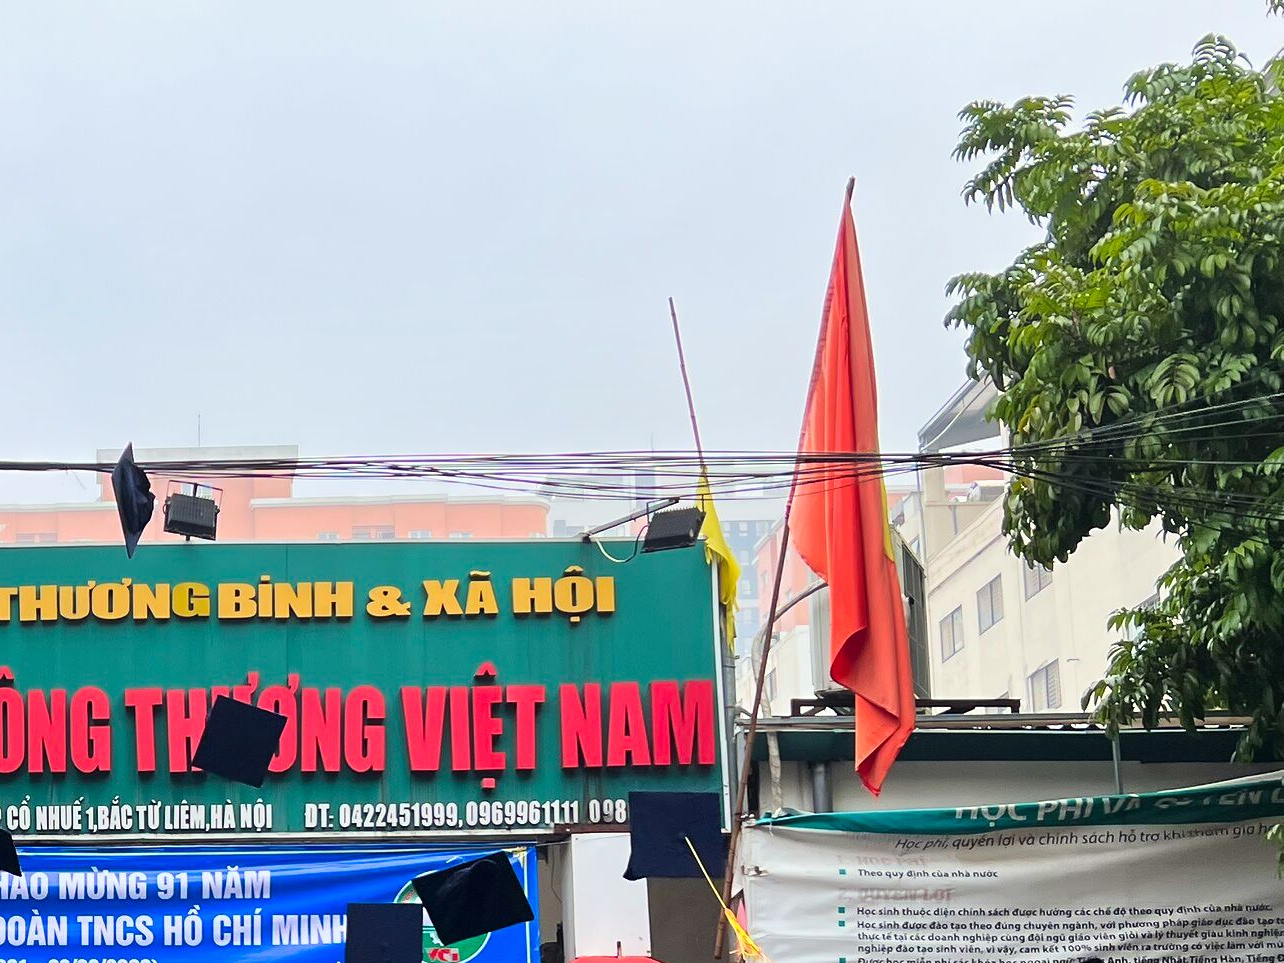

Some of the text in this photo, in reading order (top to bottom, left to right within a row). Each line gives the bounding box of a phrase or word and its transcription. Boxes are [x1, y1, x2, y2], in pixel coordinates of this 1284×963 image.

[366, 585, 411, 617] &
[422, 569, 499, 616] XÃ
[512, 564, 615, 622] HỘI
[400, 660, 546, 790] VIỆT
[559, 679, 716, 769] NAM
[7, 795, 31, 830] CỔ
[35, 797, 85, 831] NHUẾ
[137, 799, 162, 831] TỪ
[240, 798, 272, 833] NỘI
[304, 803, 334, 829] ĐT:
[339, 802, 463, 829] 0422451999,
[465, 800, 579, 826] 0969961111
[1018, 833, 1035, 846] và
[1082, 830, 1114, 845] sách
[59, 865, 147, 900] MỪNG
[157, 871, 190, 899] 91
[201, 865, 271, 899] NĂM
[858, 868, 883, 877] Theo
[885, 870, 904, 879] quy
[79, 914, 154, 947] TNCS
[163, 904, 202, 947] HỒ
[213, 908, 261, 947] CHÍ
[272, 913, 348, 946] MINH
[857, 907, 876, 917] Học
[878, 907, 900, 916] sinh
[902, 907, 931, 917] thuộc
[958, 907, 986, 916] chính
[988, 907, 1010, 916] sách
[1074, 907, 1091, 916] các
[1129, 907, 1152, 915] theo
[1154, 908, 1174, 917] quy
